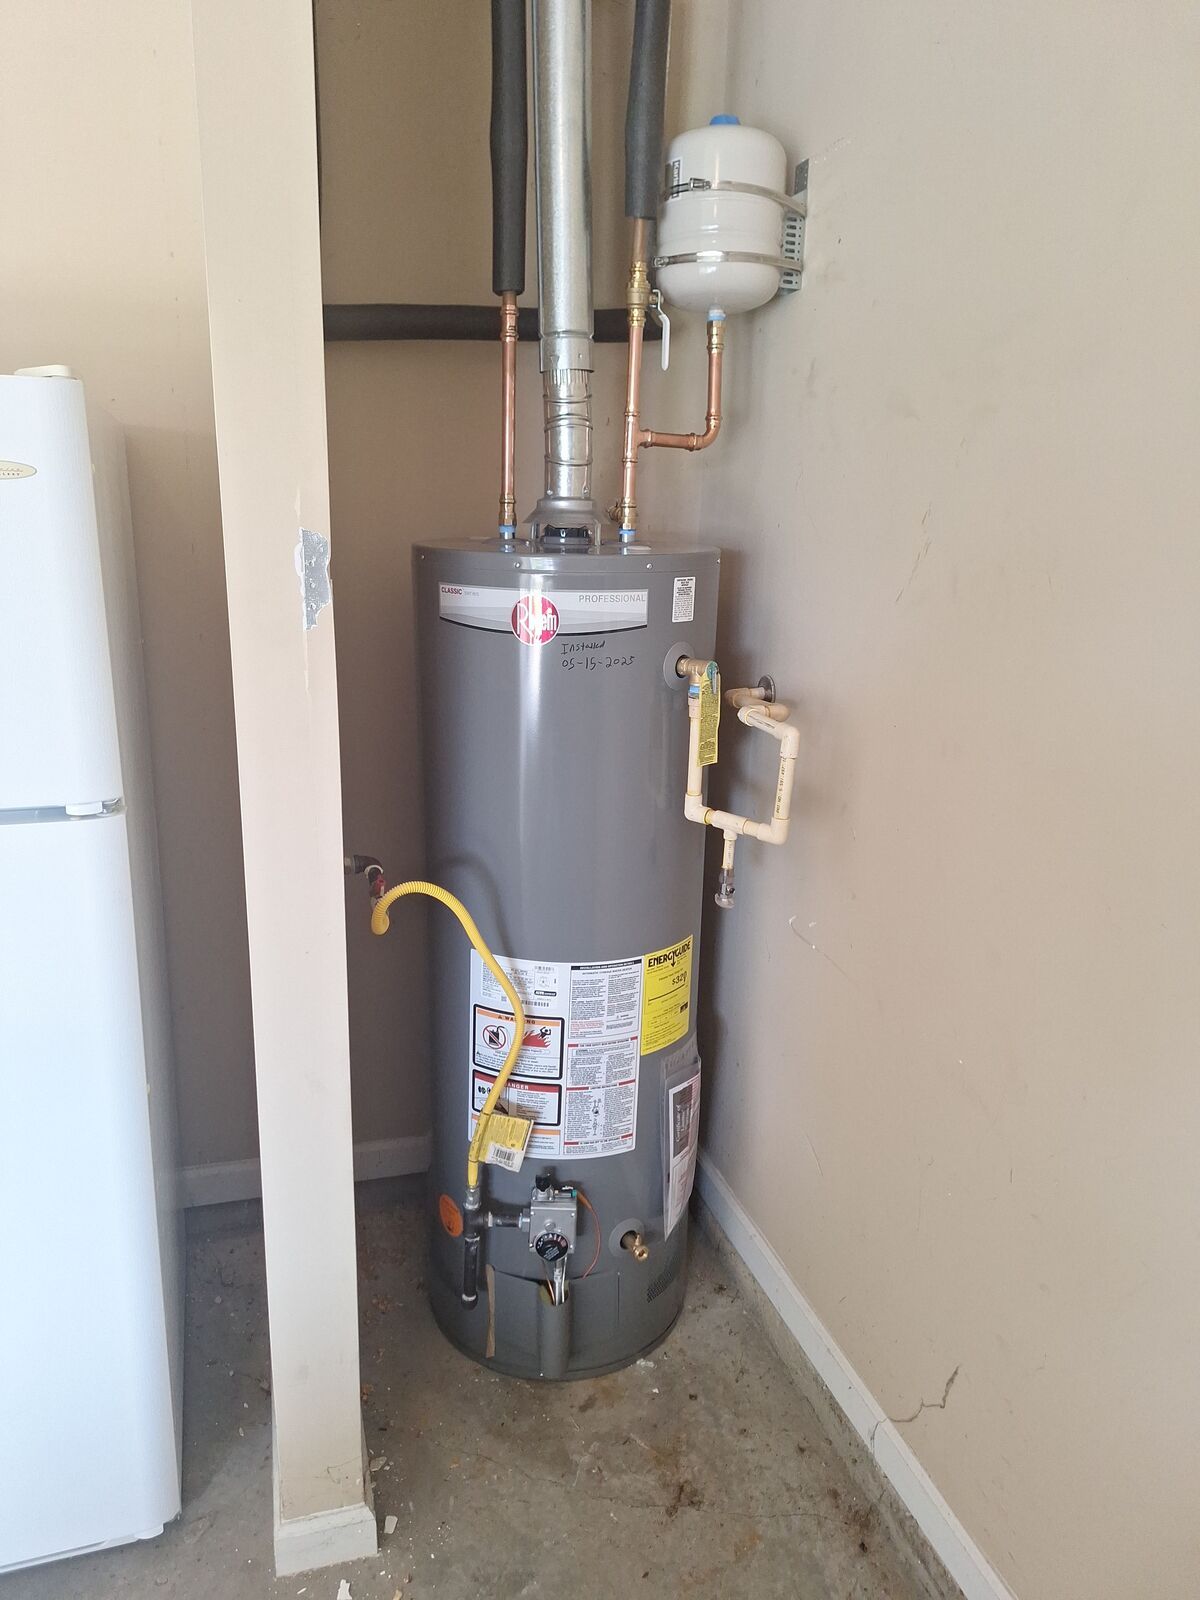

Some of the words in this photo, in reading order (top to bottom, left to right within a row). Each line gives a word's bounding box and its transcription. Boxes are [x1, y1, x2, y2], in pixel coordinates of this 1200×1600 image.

[441, 586, 463, 595] CLASSIC
[579, 594, 646, 604] PROFESSIONAL
[561, 640, 606, 655] Installed
[507, 1082, 529, 1090] ANGER
